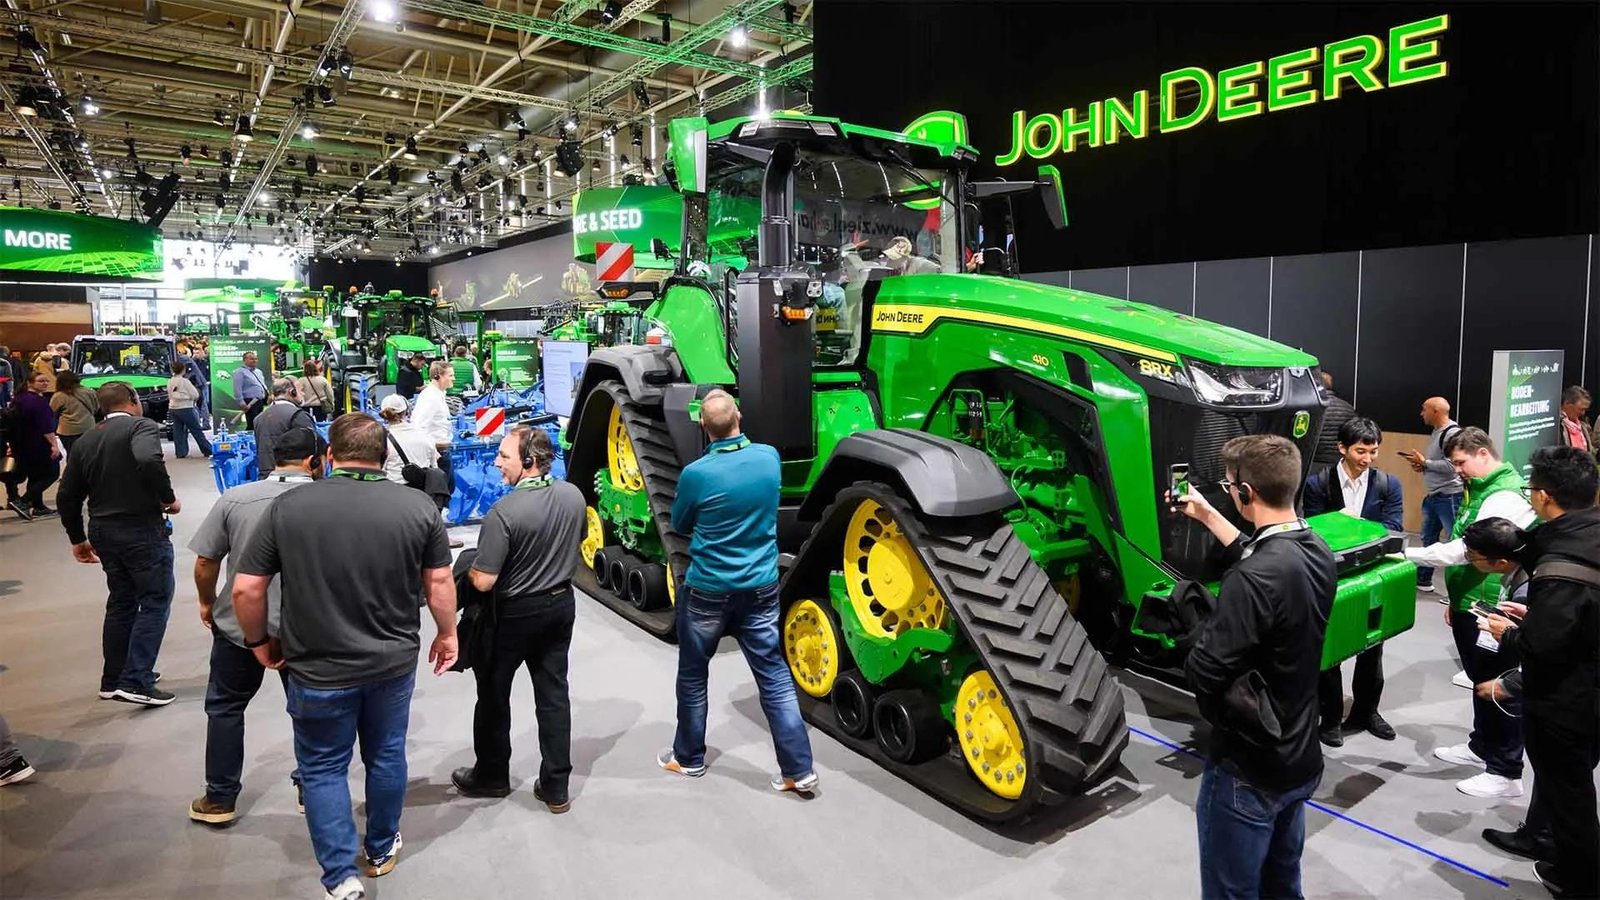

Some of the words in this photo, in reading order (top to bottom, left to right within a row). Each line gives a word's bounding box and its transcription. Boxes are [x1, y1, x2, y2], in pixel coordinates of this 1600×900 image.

[995, 89, 1149, 167] JOHN
[1160, 14, 1449, 134] DEERE
[573, 214, 588, 234] RE
[589, 212, 599, 232] &
[600, 208, 642, 230] SEED
[4, 229, 72, 251] MORE
[876, 310, 897, 323] JOHN
[897, 311, 924, 324] DEERE
[1032, 353, 1049, 367] 410
[1139, 359, 1175, 378] 8RX
